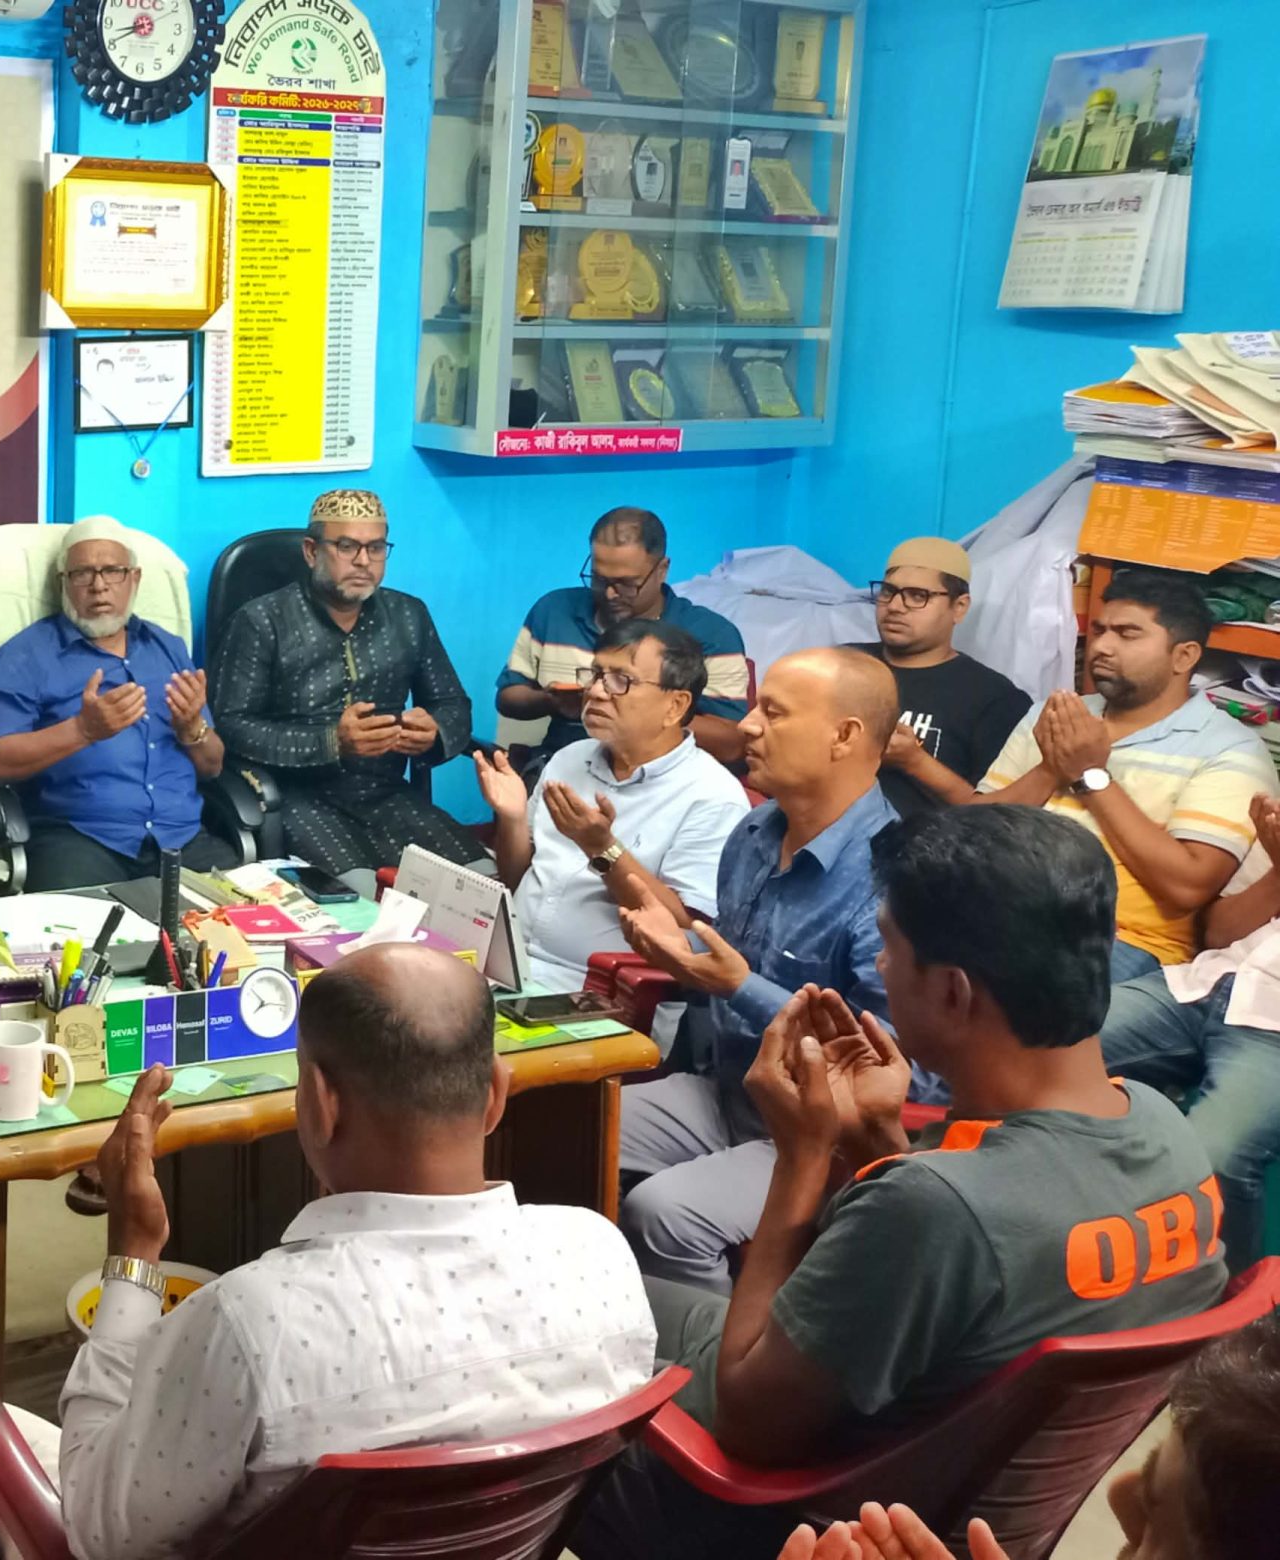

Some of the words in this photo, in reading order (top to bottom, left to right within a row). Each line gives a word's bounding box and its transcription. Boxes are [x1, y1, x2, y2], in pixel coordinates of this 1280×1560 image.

[104, 17, 114, 29] 9
[173, 23, 182, 36] 3
[246, 51, 263, 75] We
[260, 19, 310, 50] Demand
[312, 21, 338, 44] Safe
[338, 43, 360, 83] Road
[266, 73, 303, 88] ভৈরব
[307, 77, 336, 90] শাখা
[110, 1027, 138, 1038] DEVAS
